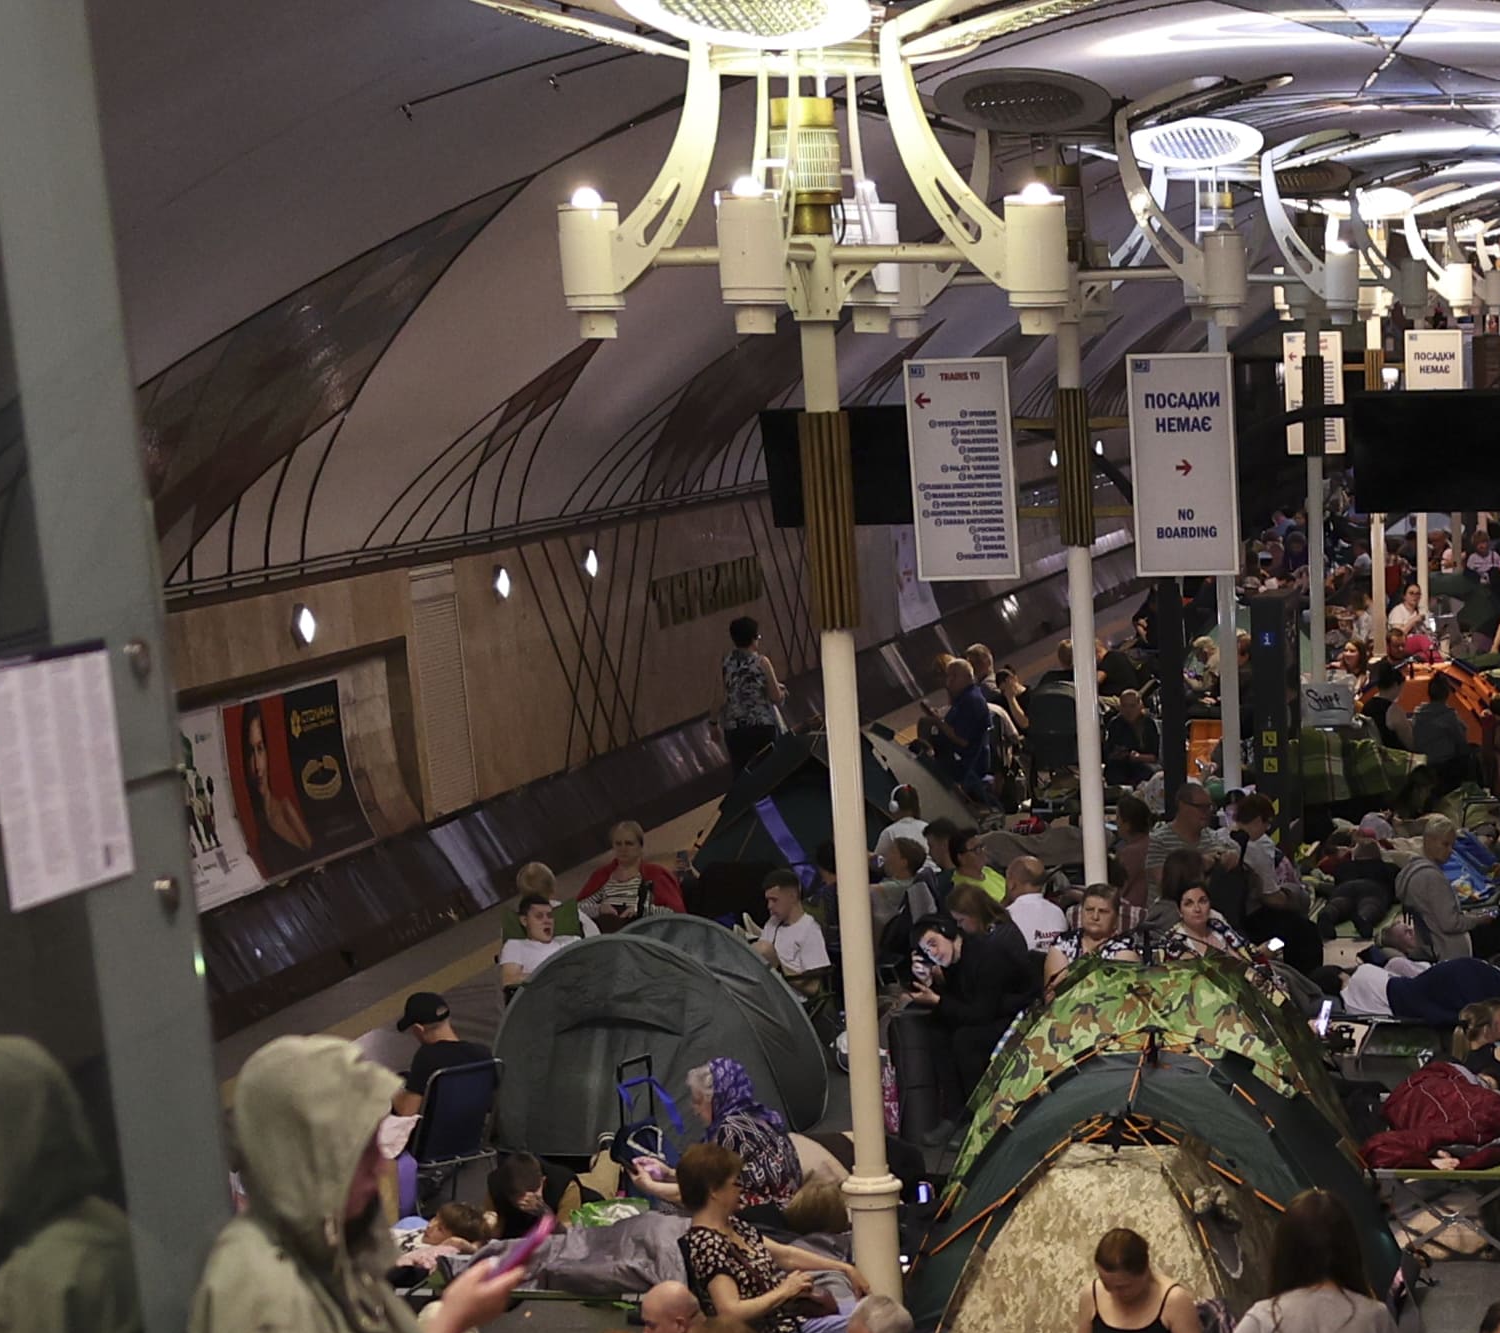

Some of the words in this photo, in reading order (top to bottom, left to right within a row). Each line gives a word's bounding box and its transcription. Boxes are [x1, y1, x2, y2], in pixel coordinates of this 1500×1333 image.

[1413, 351, 1456, 362] ПОСАДКИ
[969, 371, 980, 380] TO
[1145, 392, 1220, 410] ПОСАДКИ
[1156, 416, 1213, 433] НЕМАЄ
[1177, 508, 1194, 521] NO
[1156, 526, 1218, 539] BOARDING
